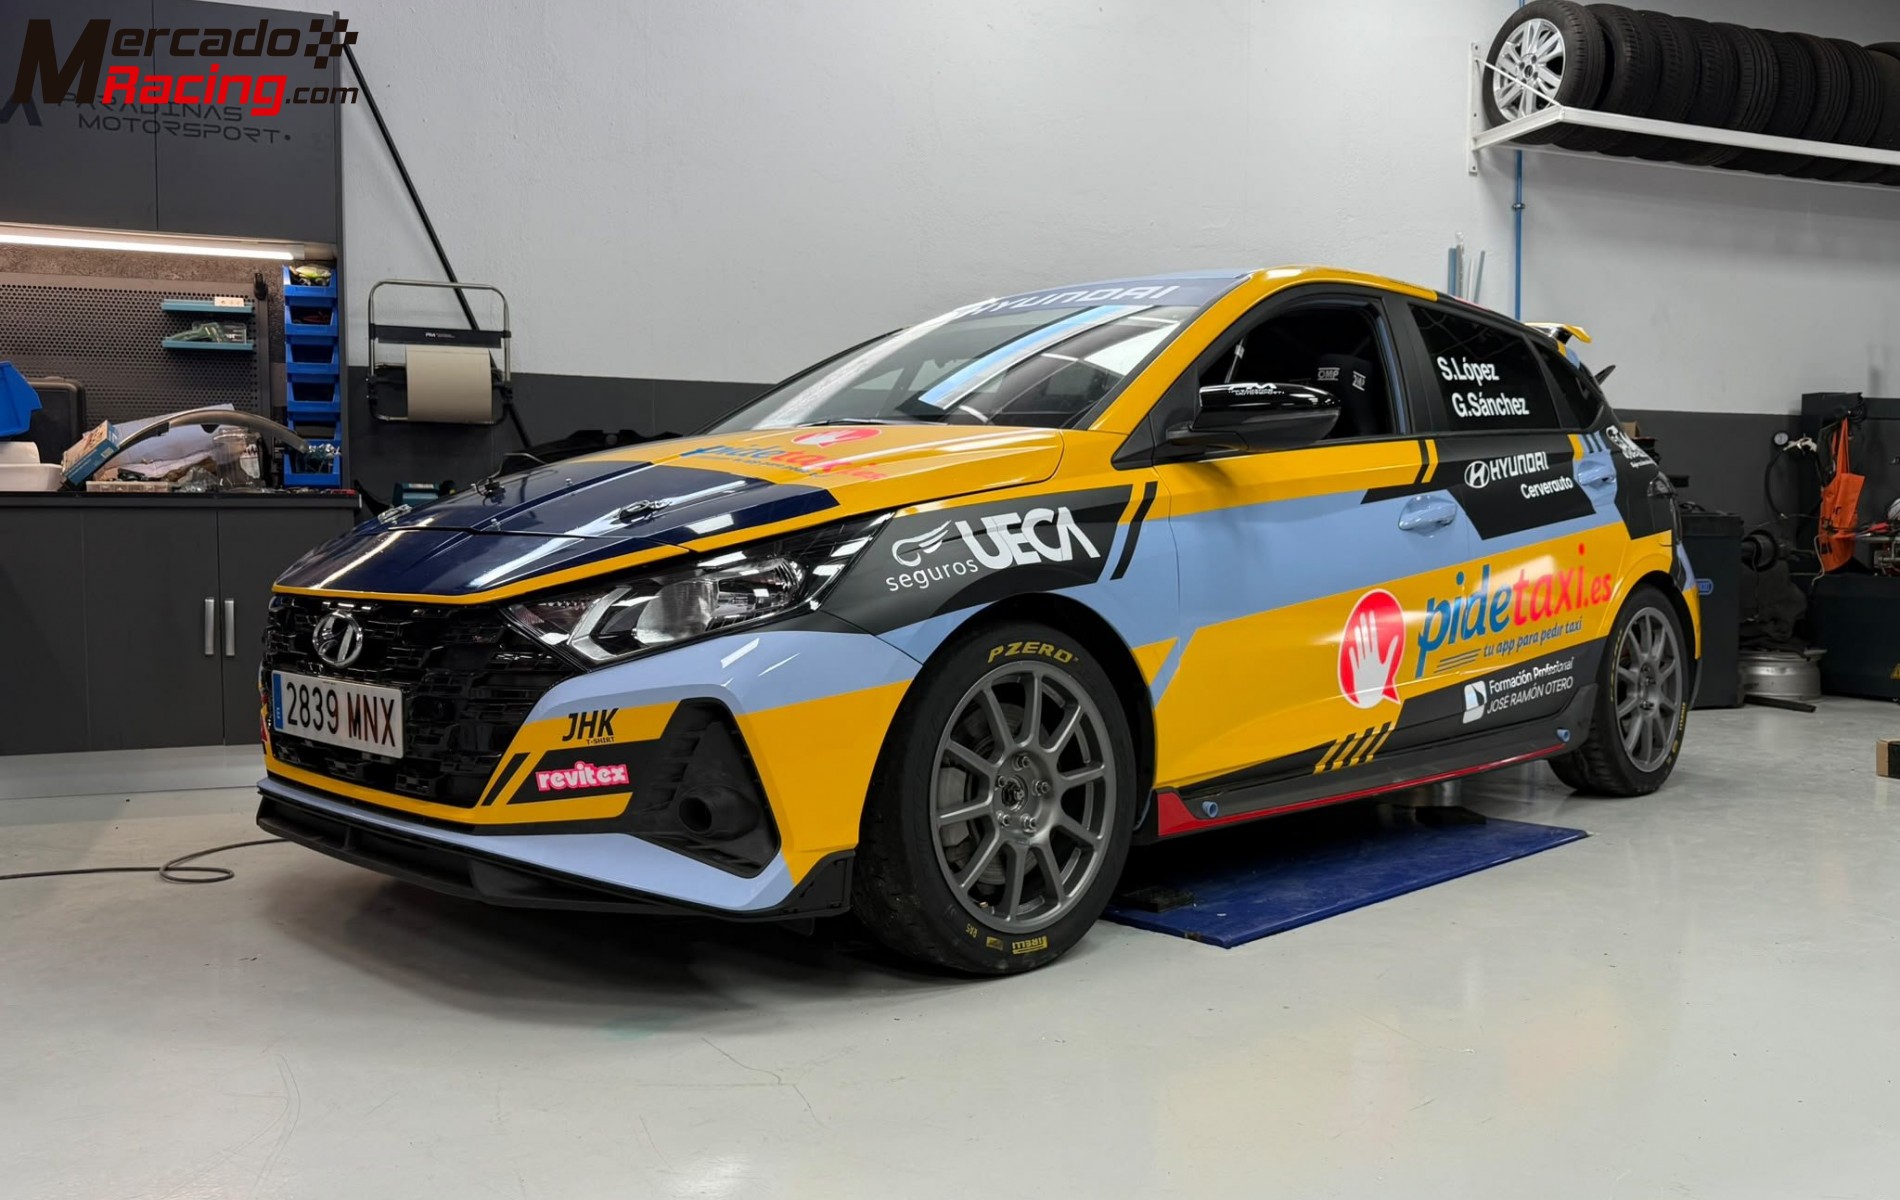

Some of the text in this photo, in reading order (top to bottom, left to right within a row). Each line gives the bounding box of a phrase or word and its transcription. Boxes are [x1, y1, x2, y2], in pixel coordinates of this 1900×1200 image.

[1317, 368, 1339, 381] OMP
[1436, 355, 1500, 387] S.López
[1451, 391, 1530, 418] G.Sánchez
[1490, 451, 1549, 481] HYUNDAI
[1520, 475, 1575, 499] Cerverauto
[954, 506, 1101, 570] UECA
[885, 557, 979, 592] seguros
[1415, 543, 1613, 679] pidetaxi.es
[1484, 615, 1583, 658] tu app para pedir taxi
[1489, 656, 1575, 694] Formación Profesional
[1510, 682, 1545, 707] RAMÓN
[1545, 675, 1574, 695] OTERO
[287, 682, 396, 747] 2839 MNX
[562, 708, 619, 742] JHK
[536, 761, 629, 791] revitex
[1012, 935, 1049, 955] PIRELLI
